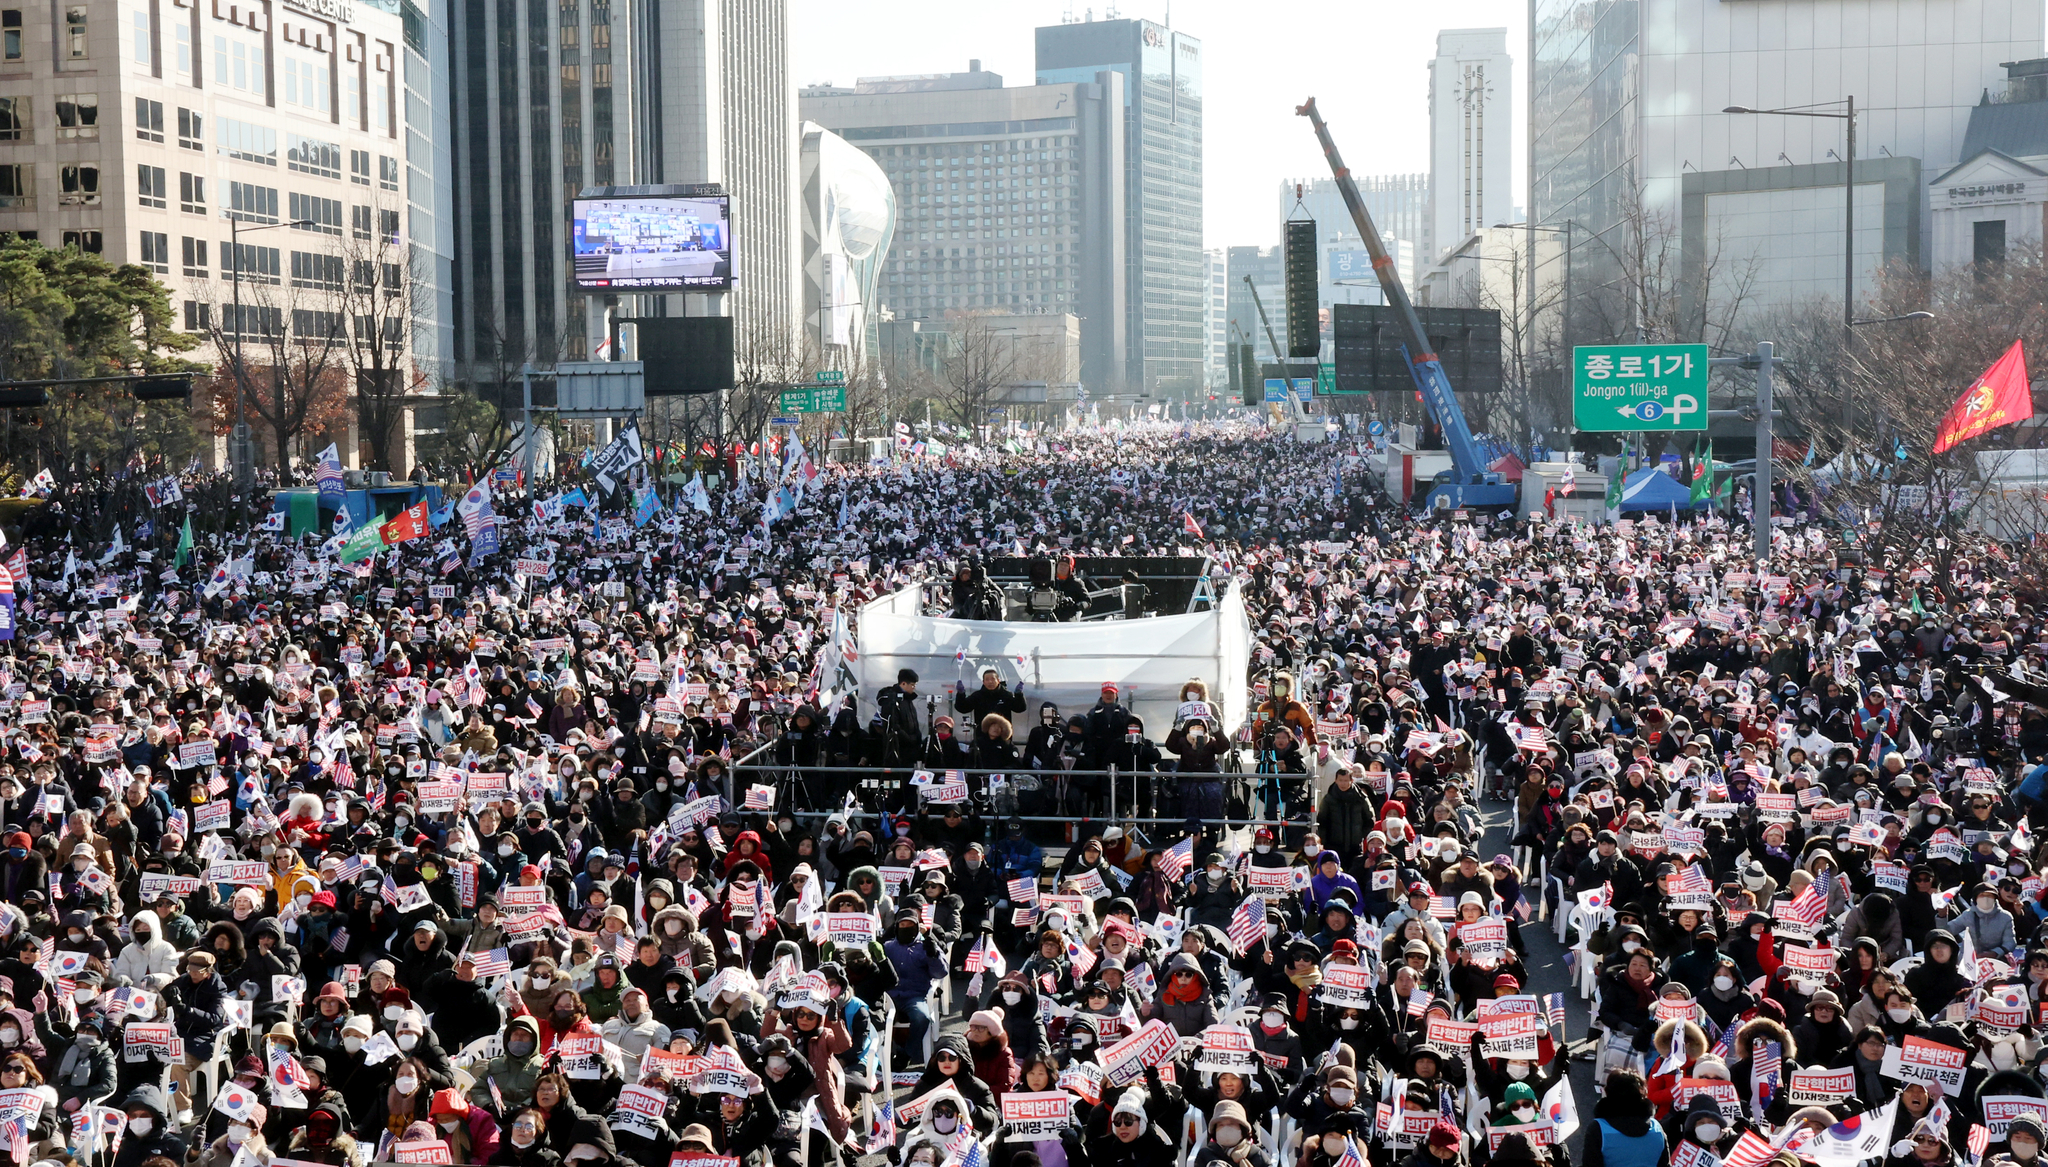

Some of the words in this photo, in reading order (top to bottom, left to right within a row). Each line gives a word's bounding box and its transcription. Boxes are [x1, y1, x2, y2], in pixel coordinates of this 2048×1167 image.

[1948, 182, 2026, 198] 한국금융사박물관
[1584, 353, 1694, 379] 종로1가
[1584, 383, 1626, 400] Jongno
[1630, 382, 1668, 399] 1(il)-ga
[1644, 404, 1655, 418] 6
[517, 562, 532, 573] 부산
[532, 564, 548, 575] 28호
[432, 587, 444, 596] 부산
[444, 587, 452, 596] 11
[182, 744, 212, 757] 탄핵반대
[469, 779, 504, 788] 탄핵반대
[420, 787, 458, 797] 탄핵반대
[941, 783, 966, 801] 저지!
[421, 799, 443, 808] 이재명
[1759, 799, 1795, 808] 탄핵반대
[197, 805, 228, 820] 탄핵반대
[215, 815, 228, 824] 구속
[1813, 808, 1848, 819] 탄핵반대
[1665, 832, 1703, 841] 탄핵반대
[1928, 847, 1950, 858] 주사파
[209, 865, 233, 878] 탄핵
[234, 864, 264, 880] 저지!
[143, 880, 168, 891] 탄핵
[1081, 873, 1100, 889] 핵반대
[1877, 877, 1900, 886] 주사파
[1251, 886, 1274, 895] 이재명
[505, 892, 544, 904] 탄핵반대
[503, 906, 527, 914] 이재명
[505, 915, 544, 932] 탄핵반대
[830, 920, 873, 933] 탄핵반대
[830, 934, 855, 944] 이재명
[1469, 944, 1491, 953] 이재명
[1786, 954, 1831, 968] 탄핵반대
[1325, 971, 1368, 988] 탄핵반대
[782, 991, 808, 1002] 이재명
[1322, 987, 1350, 996] 이재명
[1979, 1007, 2021, 1024] 핵반대
[1480, 1016, 1535, 1036] 탄핵반대
[127, 1028, 168, 1044] 탄핵반대
[1432, 1026, 1471, 1041] 탄핵반
[563, 1035, 600, 1054] 핵반대
[1204, 1032, 1251, 1050] 탄핵반대
[1482, 1040, 1512, 1054] 주사파
[1512, 1036, 1536, 1051] 척결
[154, 1046, 169, 1057] 구속
[1458, 1045, 1470, 1054] 구
[1904, 1045, 1964, 1068] 탄핵반대
[1110, 1057, 1144, 1086] 탄핵
[1140, 1028, 1175, 1068] 저지!
[1200, 1052, 1230, 1064] 이재명
[1899, 1064, 1937, 1080] 주사파
[1940, 1071, 1961, 1086] 척결
[1058, 1075, 1100, 1100] 탄핵반대
[1797, 1076, 1852, 1091] 탄핵반대
[0, 1093, 42, 1111] 핵반대
[1005, 1101, 1065, 1118] 탄핵반대
[1722, 1106, 1741, 1117] 척결
[1988, 1102, 2046, 1119] 탄핵반대
[1006, 1121, 1040, 1134] 이재명
[1043, 1121, 1067, 1134] 구속
[1380, 1111, 1438, 1133] 탄반대
